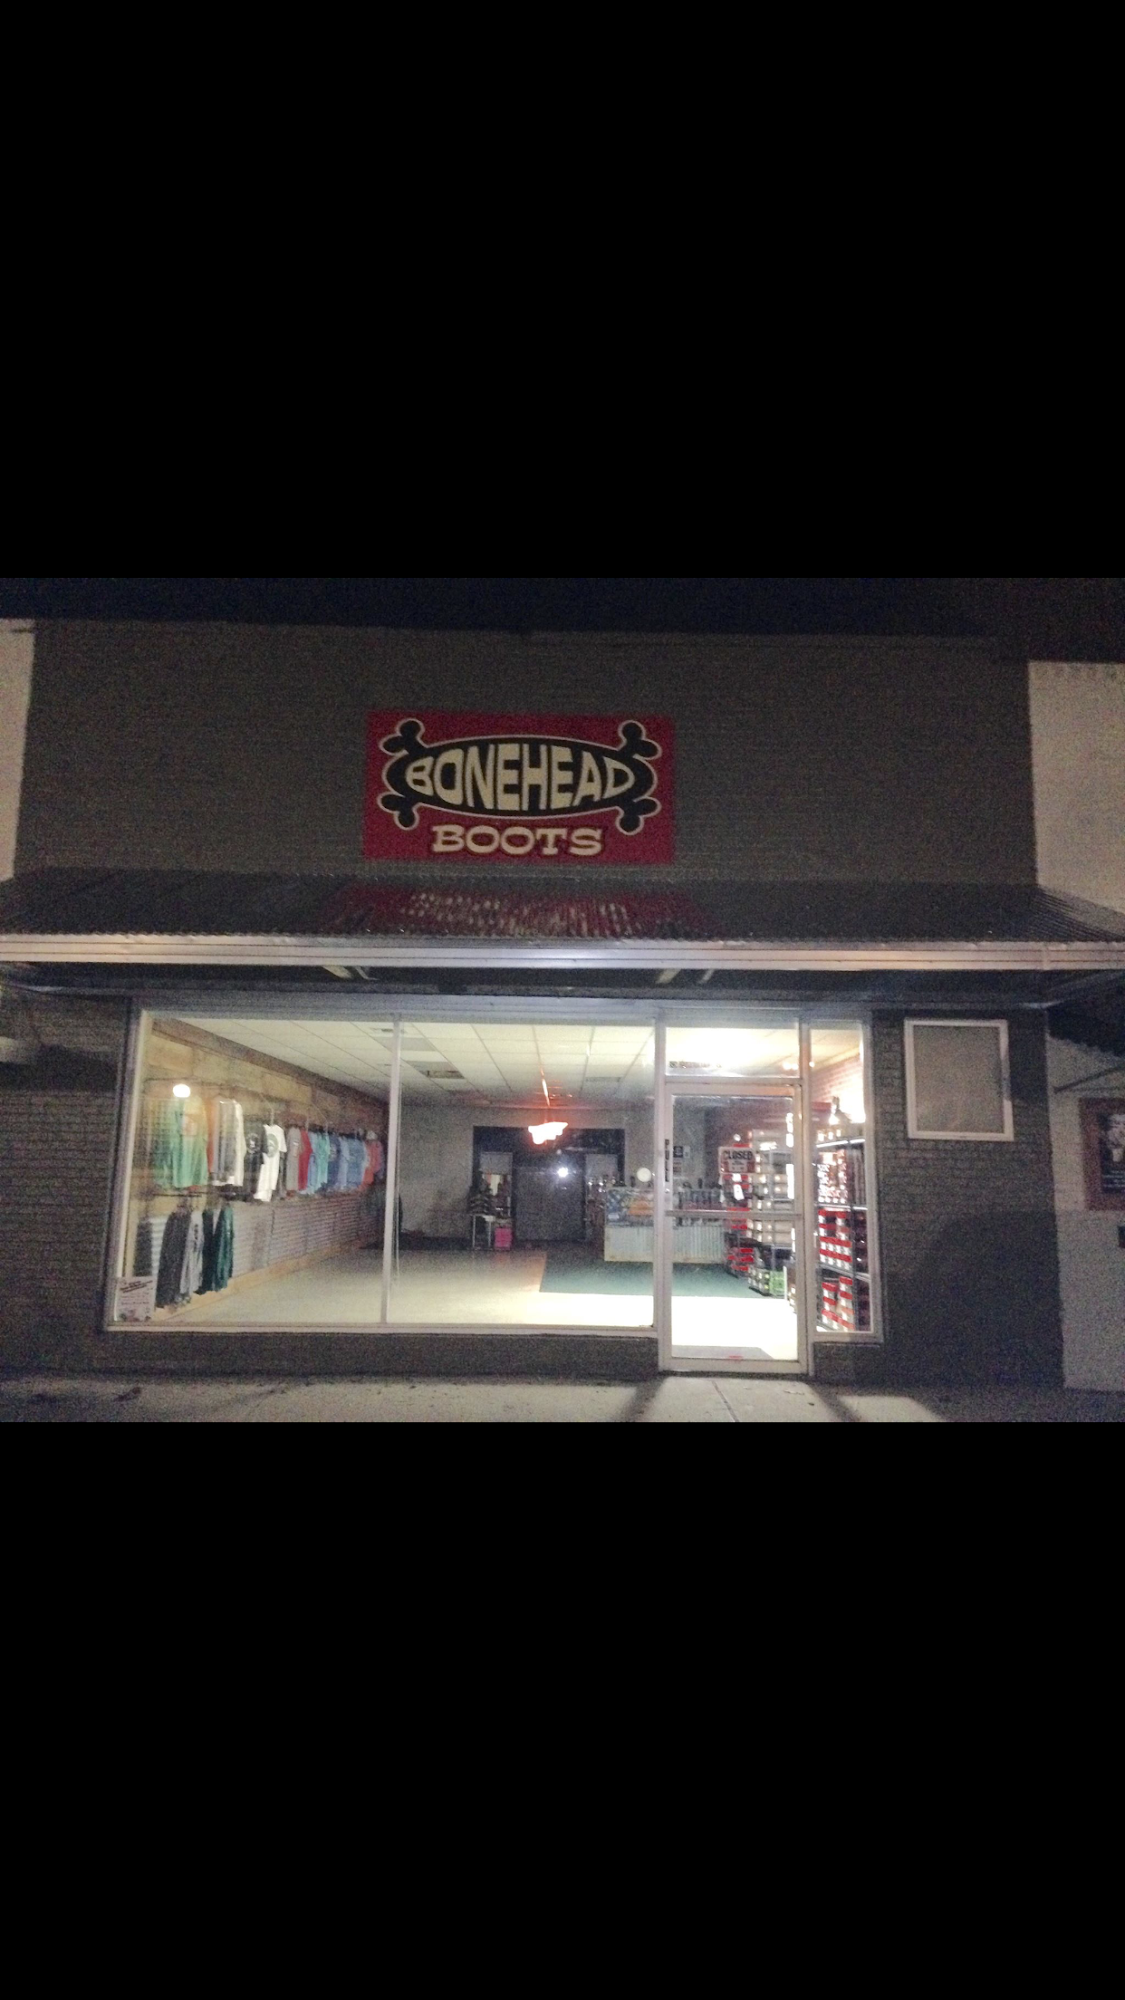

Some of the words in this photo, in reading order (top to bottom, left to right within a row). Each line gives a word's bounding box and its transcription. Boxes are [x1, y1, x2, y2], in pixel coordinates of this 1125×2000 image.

[405, 743, 635, 811] BONEHEAD
[432, 825, 603, 856] BOOTS
[722, 1150, 753, 1160] CLOSED
